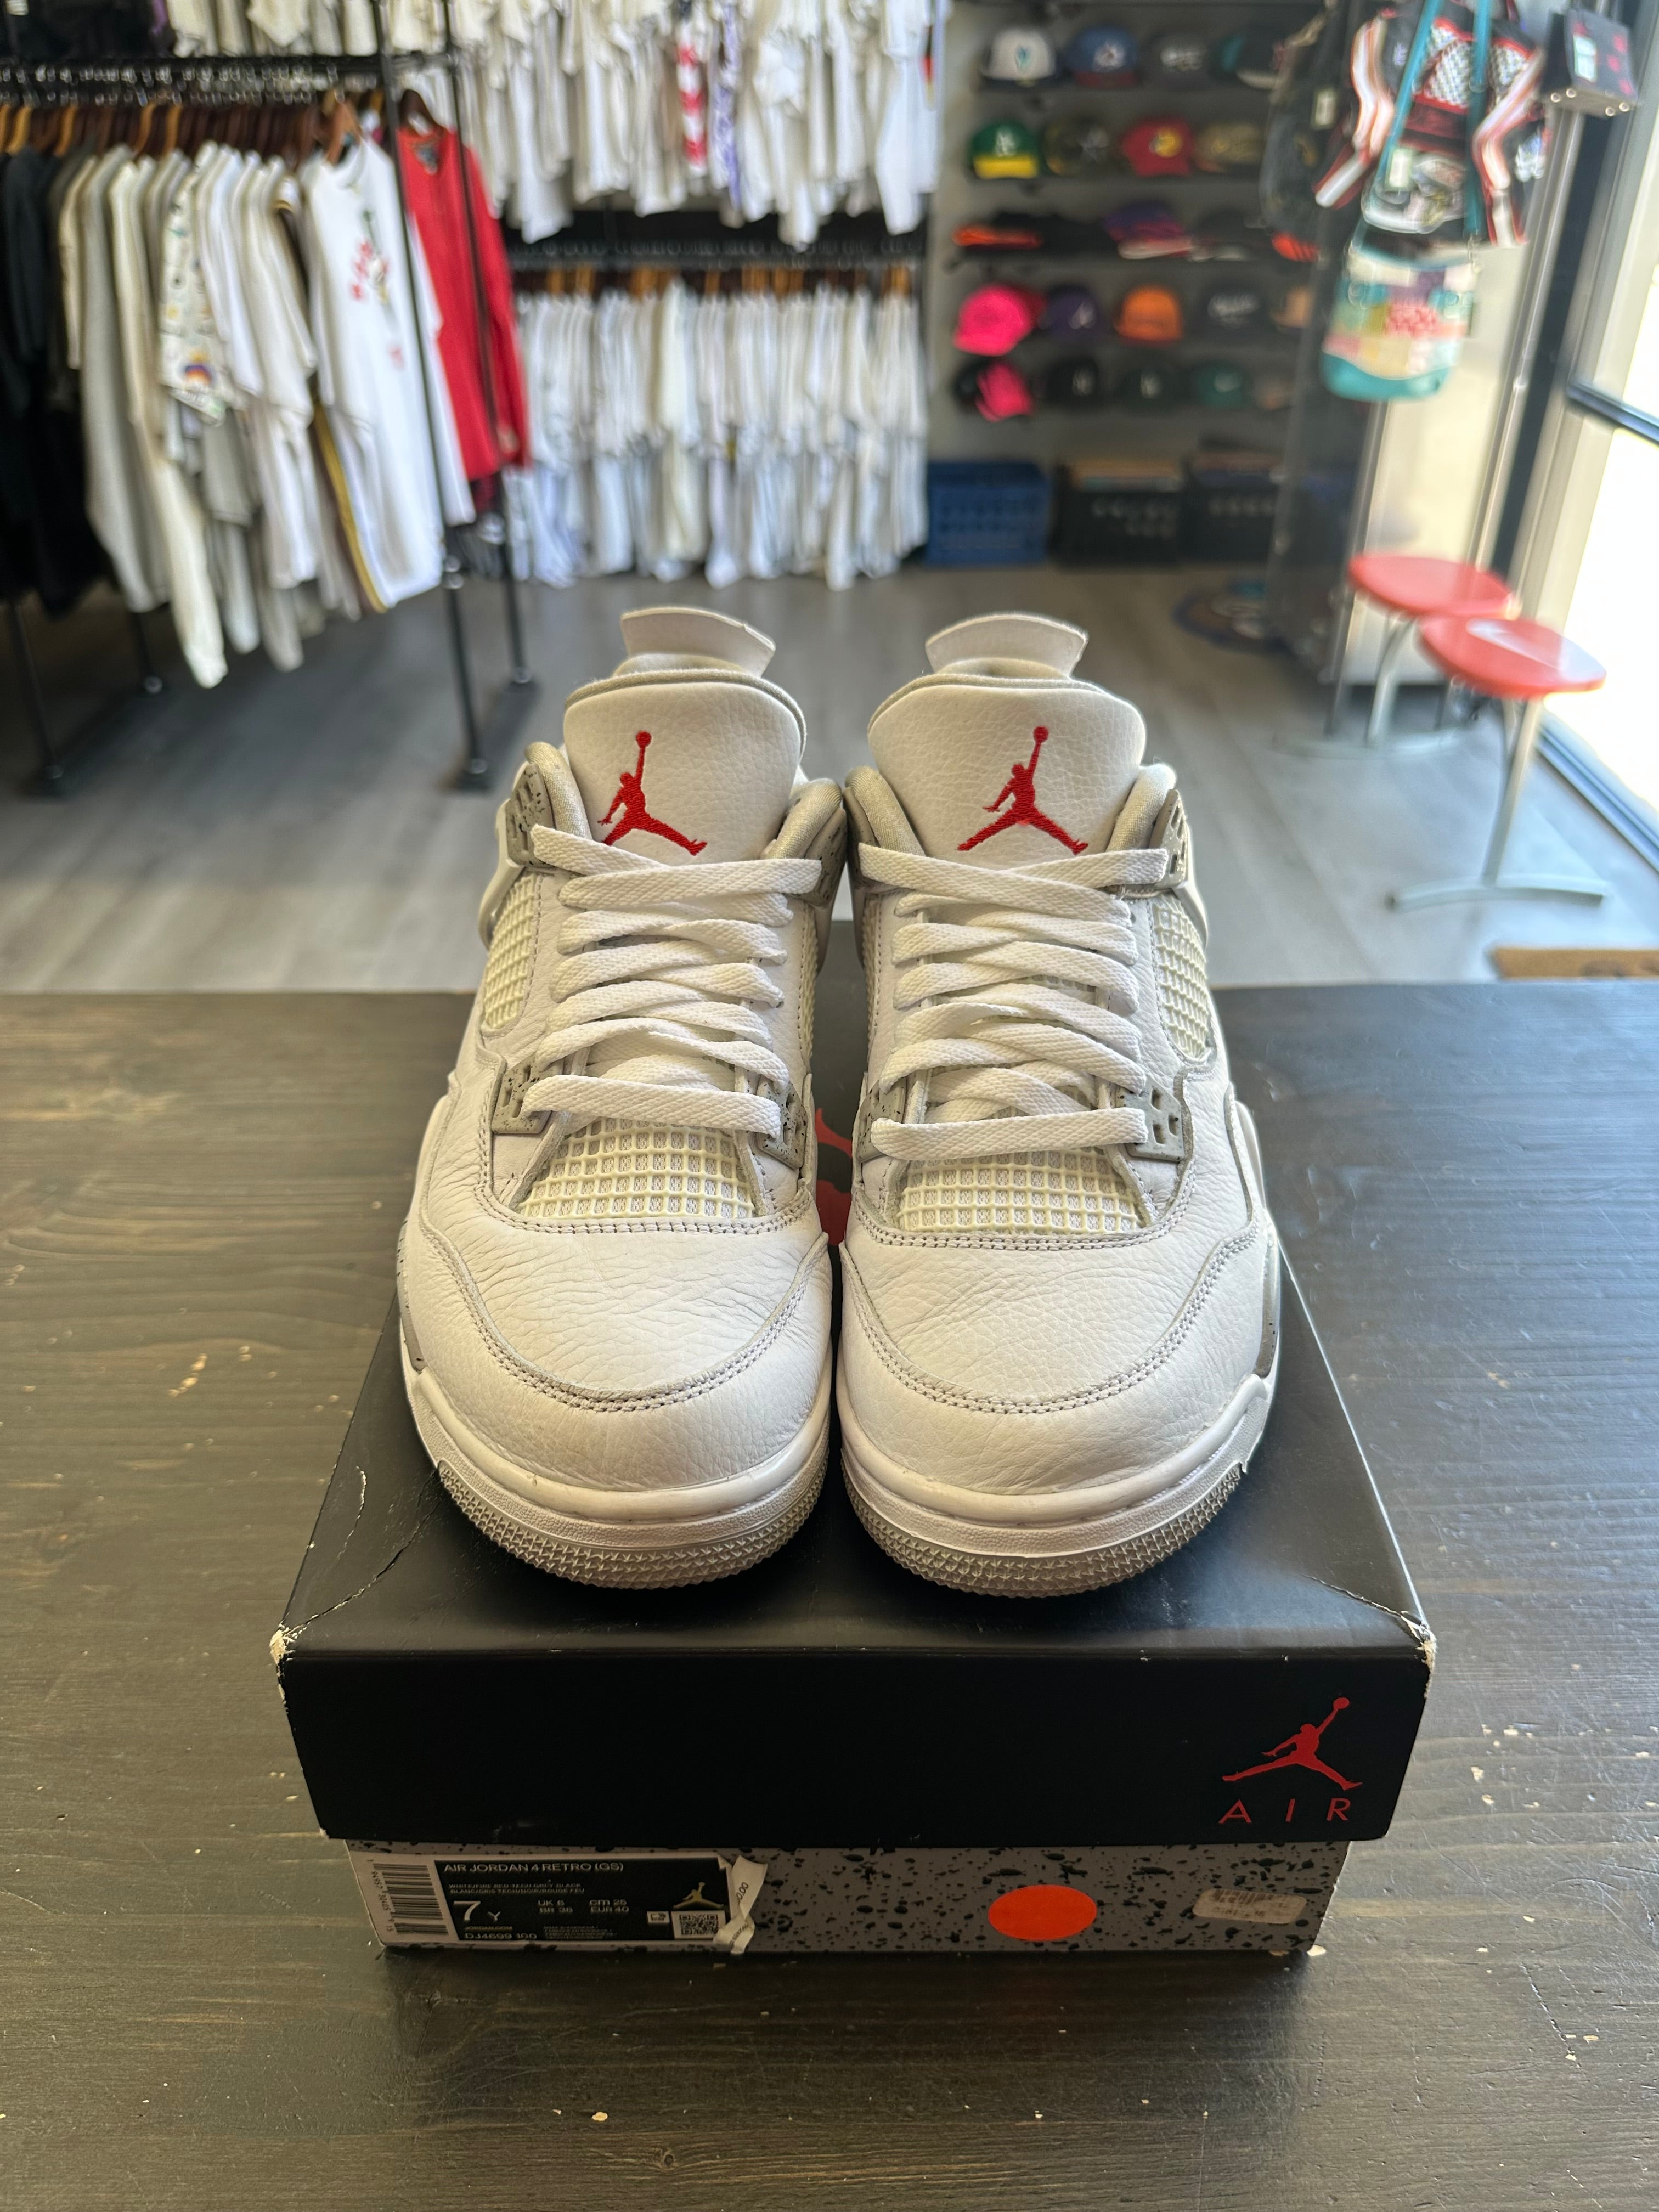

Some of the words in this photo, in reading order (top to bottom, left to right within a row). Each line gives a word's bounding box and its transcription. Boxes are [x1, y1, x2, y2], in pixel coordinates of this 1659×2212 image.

[1218, 1798, 1351, 1824] AIR
[444, 1864, 466, 1872] AIR
[470, 1863, 528, 1872] JORDAN
[531, 1863, 539, 1872] 4
[541, 1863, 591, 1872] RETRO
[595, 1862, 624, 1872] (GS)
[453, 1900, 481, 1921] 7
[487, 1911, 501, 1921] Y
